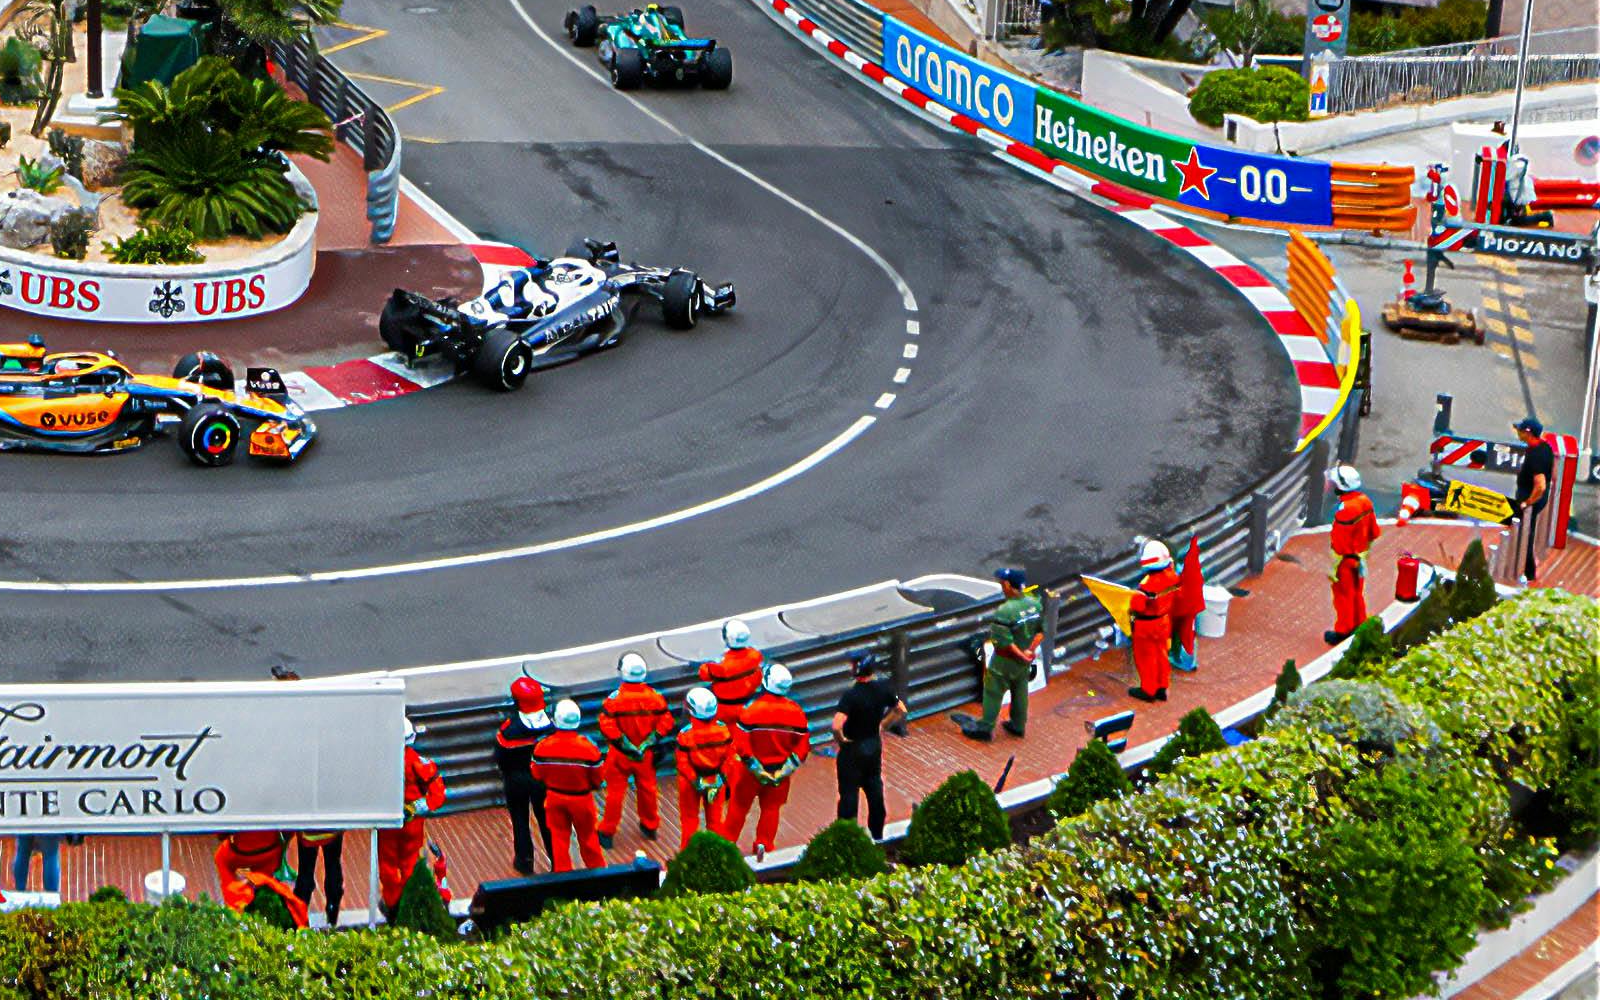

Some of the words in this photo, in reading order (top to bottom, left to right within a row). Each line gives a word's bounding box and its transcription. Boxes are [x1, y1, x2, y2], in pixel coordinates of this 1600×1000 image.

[896, 33, 1015, 129] aramco
[1035, 103, 1167, 184] Heineken
[19, 270, 101, 314] UBS
[193, 273, 267, 317] UBS
[77, 786, 228, 818] CARLO
